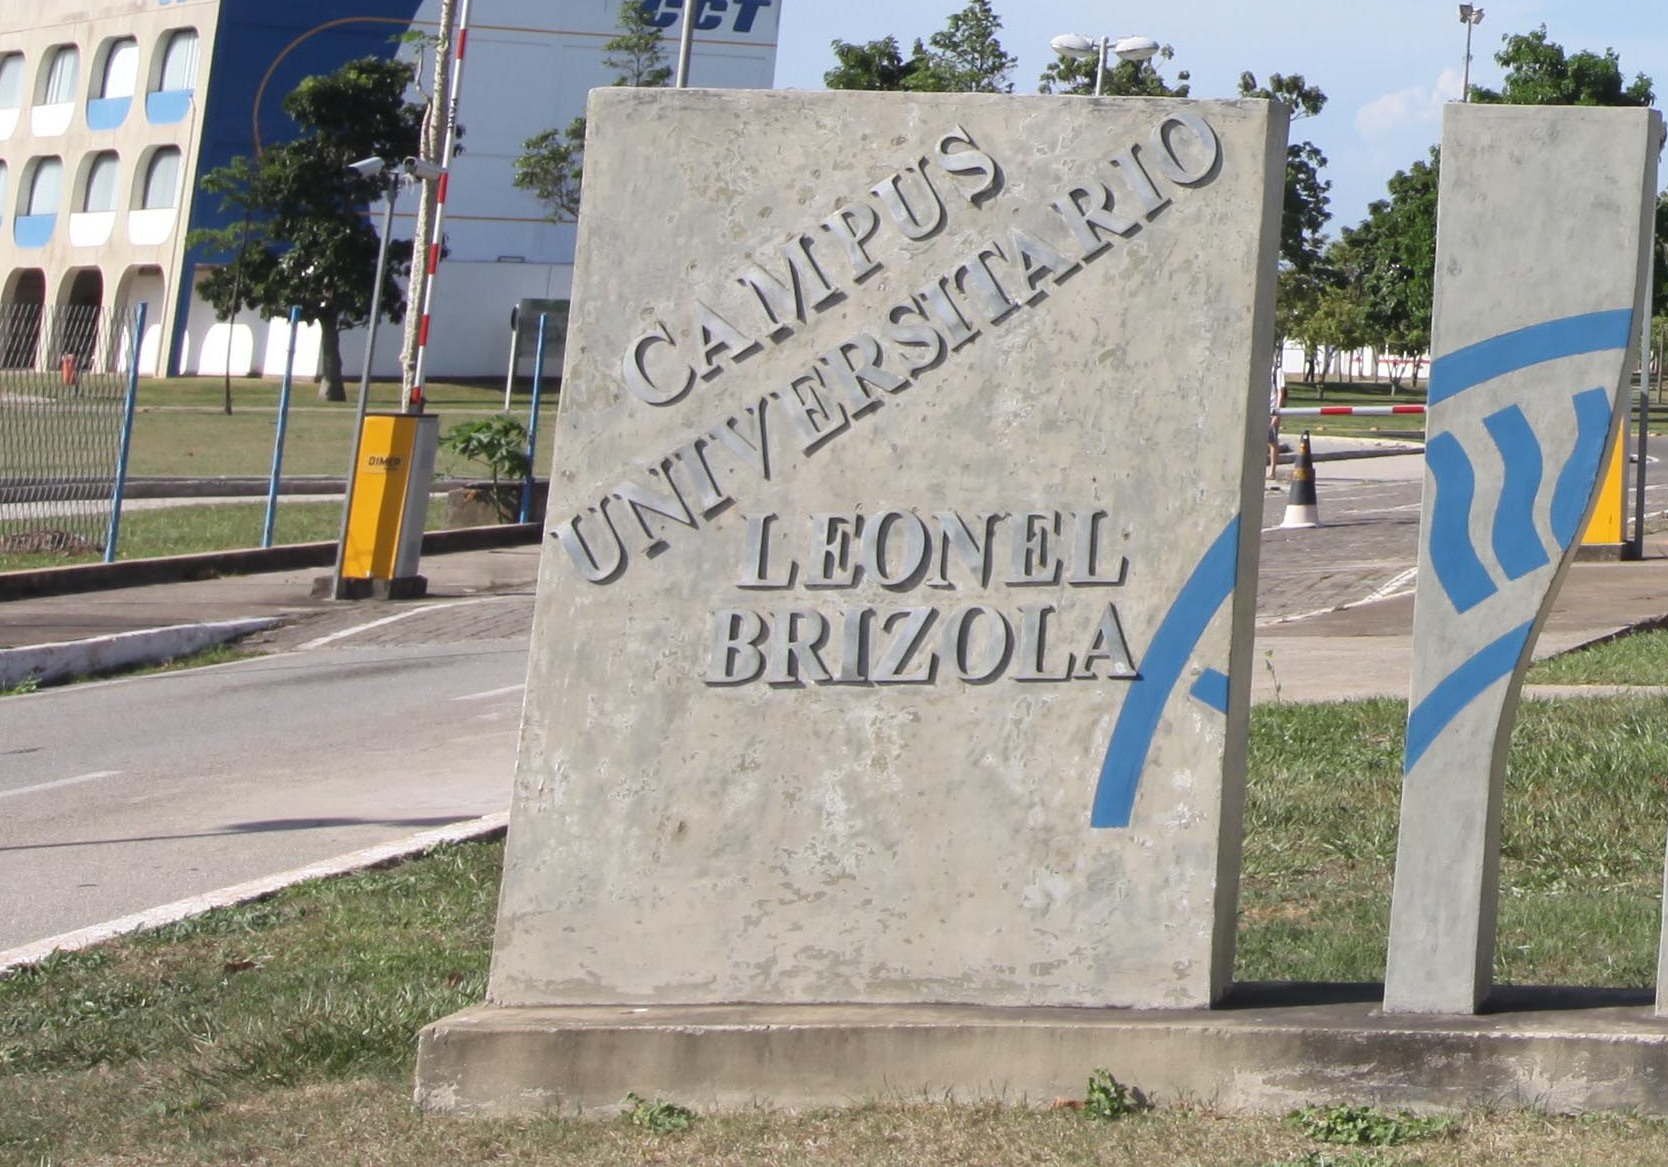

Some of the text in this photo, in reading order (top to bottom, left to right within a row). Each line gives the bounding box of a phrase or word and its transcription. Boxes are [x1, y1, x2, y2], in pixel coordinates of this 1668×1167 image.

[555, 111, 1224, 585] UNIVERSITARIO
[619, 124, 1005, 407] CAMPUS
[736, 509, 1129, 591] LEONEL
[705, 601, 1141, 688] BRIZOLA
